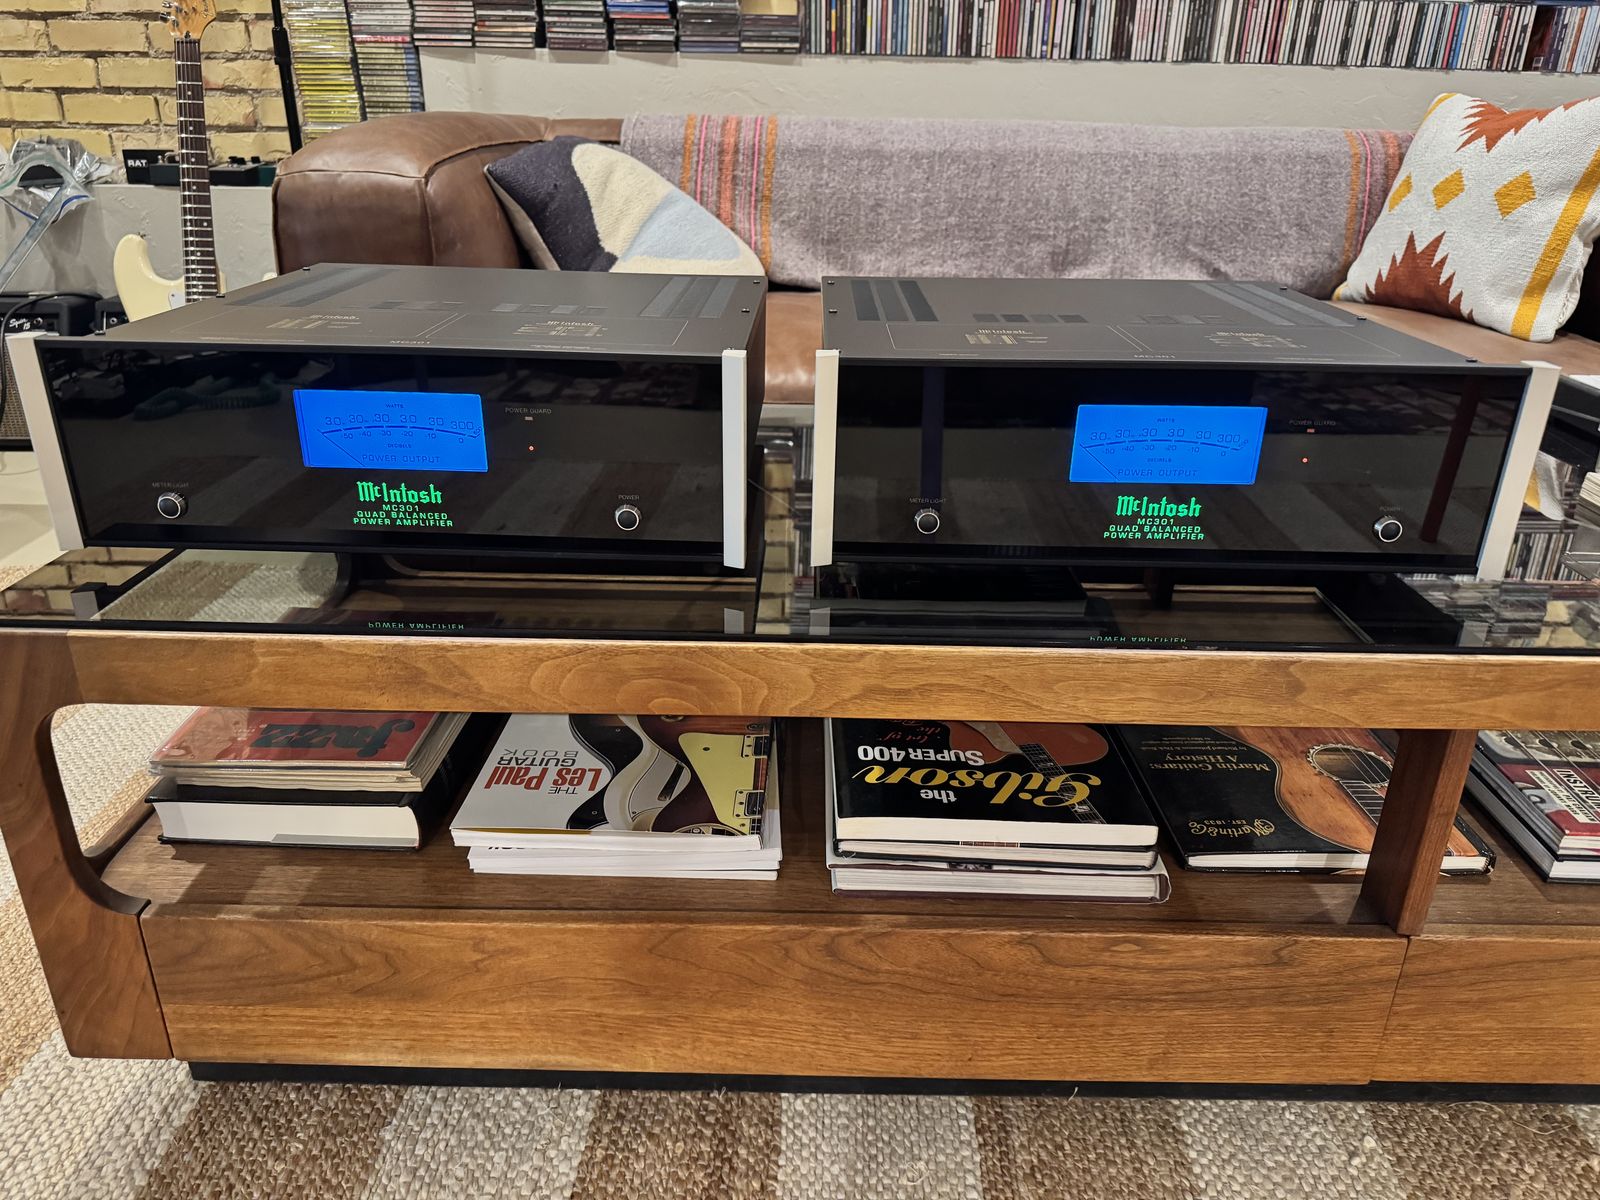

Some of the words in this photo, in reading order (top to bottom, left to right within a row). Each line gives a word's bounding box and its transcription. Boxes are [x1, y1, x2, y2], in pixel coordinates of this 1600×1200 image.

[127, 159, 147, 168] RAT
[450, 420, 474, 430] 300
[1217, 433, 1241, 443] 300
[362, 454, 398, 463] POWER
[403, 454, 441, 464] OUTPUT
[1117, 469, 1153, 478] POWER
[1158, 469, 1199, 478] OUTPUT
[356, 481, 443, 504] McIntosh
[382, 504, 419, 512] MC301
[1116, 495, 1202, 517] McIntosh
[356, 510, 386, 518] QUAD
[391, 511, 448, 520] BALANCED
[353, 517, 391, 526] POWER
[396, 519, 453, 527] AMPLIFIER
[1137, 518, 1174, 526] MC301
[1144, 525, 1201, 533] BALANCED
[1103, 531, 1141, 539] POWER
[1146, 532, 1205, 540] AMPLIFIER
[251, 719, 415, 758] jazz
[500, 749, 579, 758] BOOK
[857, 745, 906, 762] 400
[1165, 753, 1223, 763] History
[497, 756, 577, 767] GUITAR
[1149, 762, 1213, 771] Guitars:
[1216, 762, 1271, 772] Martin
[484, 766, 549, 790] Paul
[552, 767, 603, 791] Les
[548, 786, 578, 794] THE
[851, 766, 1102, 807] Gibson
[920, 788, 957, 803] the
